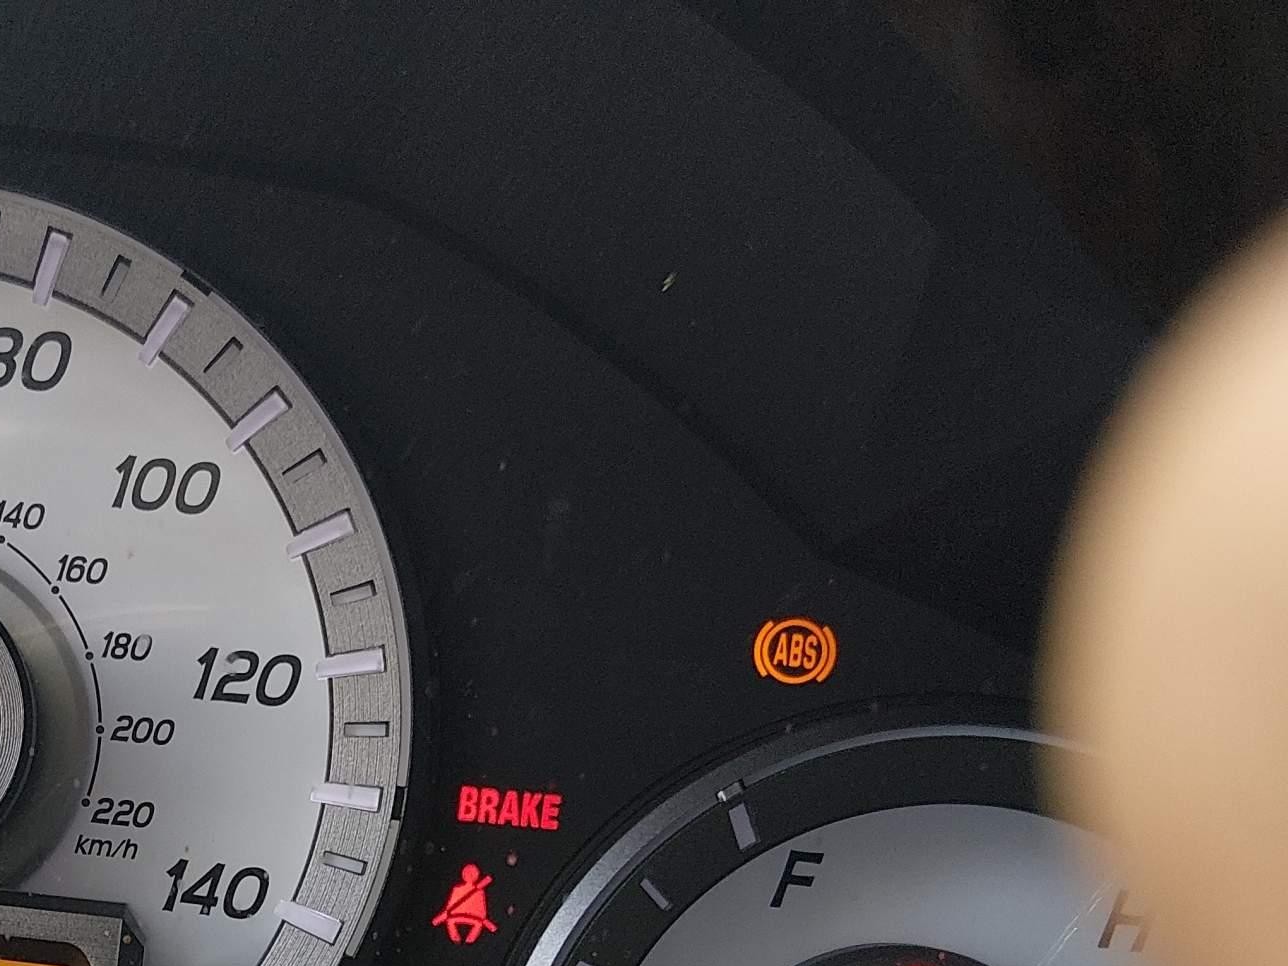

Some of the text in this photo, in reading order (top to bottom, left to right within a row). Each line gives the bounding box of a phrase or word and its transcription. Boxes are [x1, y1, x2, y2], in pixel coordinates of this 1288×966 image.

[112, 455, 220, 514] 100
[56, 555, 107, 585] 160
[101, 632, 152, 661] 180
[773, 632, 818, 671] ABS
[193, 648, 301, 706] 120
[110, 716, 174, 746] 200
[89, 798, 154, 828] 220
[458, 784, 562, 830] BRAKE
[74, 834, 137, 860] km/h
[162, 860, 269, 919] 140
[770, 850, 824, 909] F
[1098, 889, 1155, 953] H
